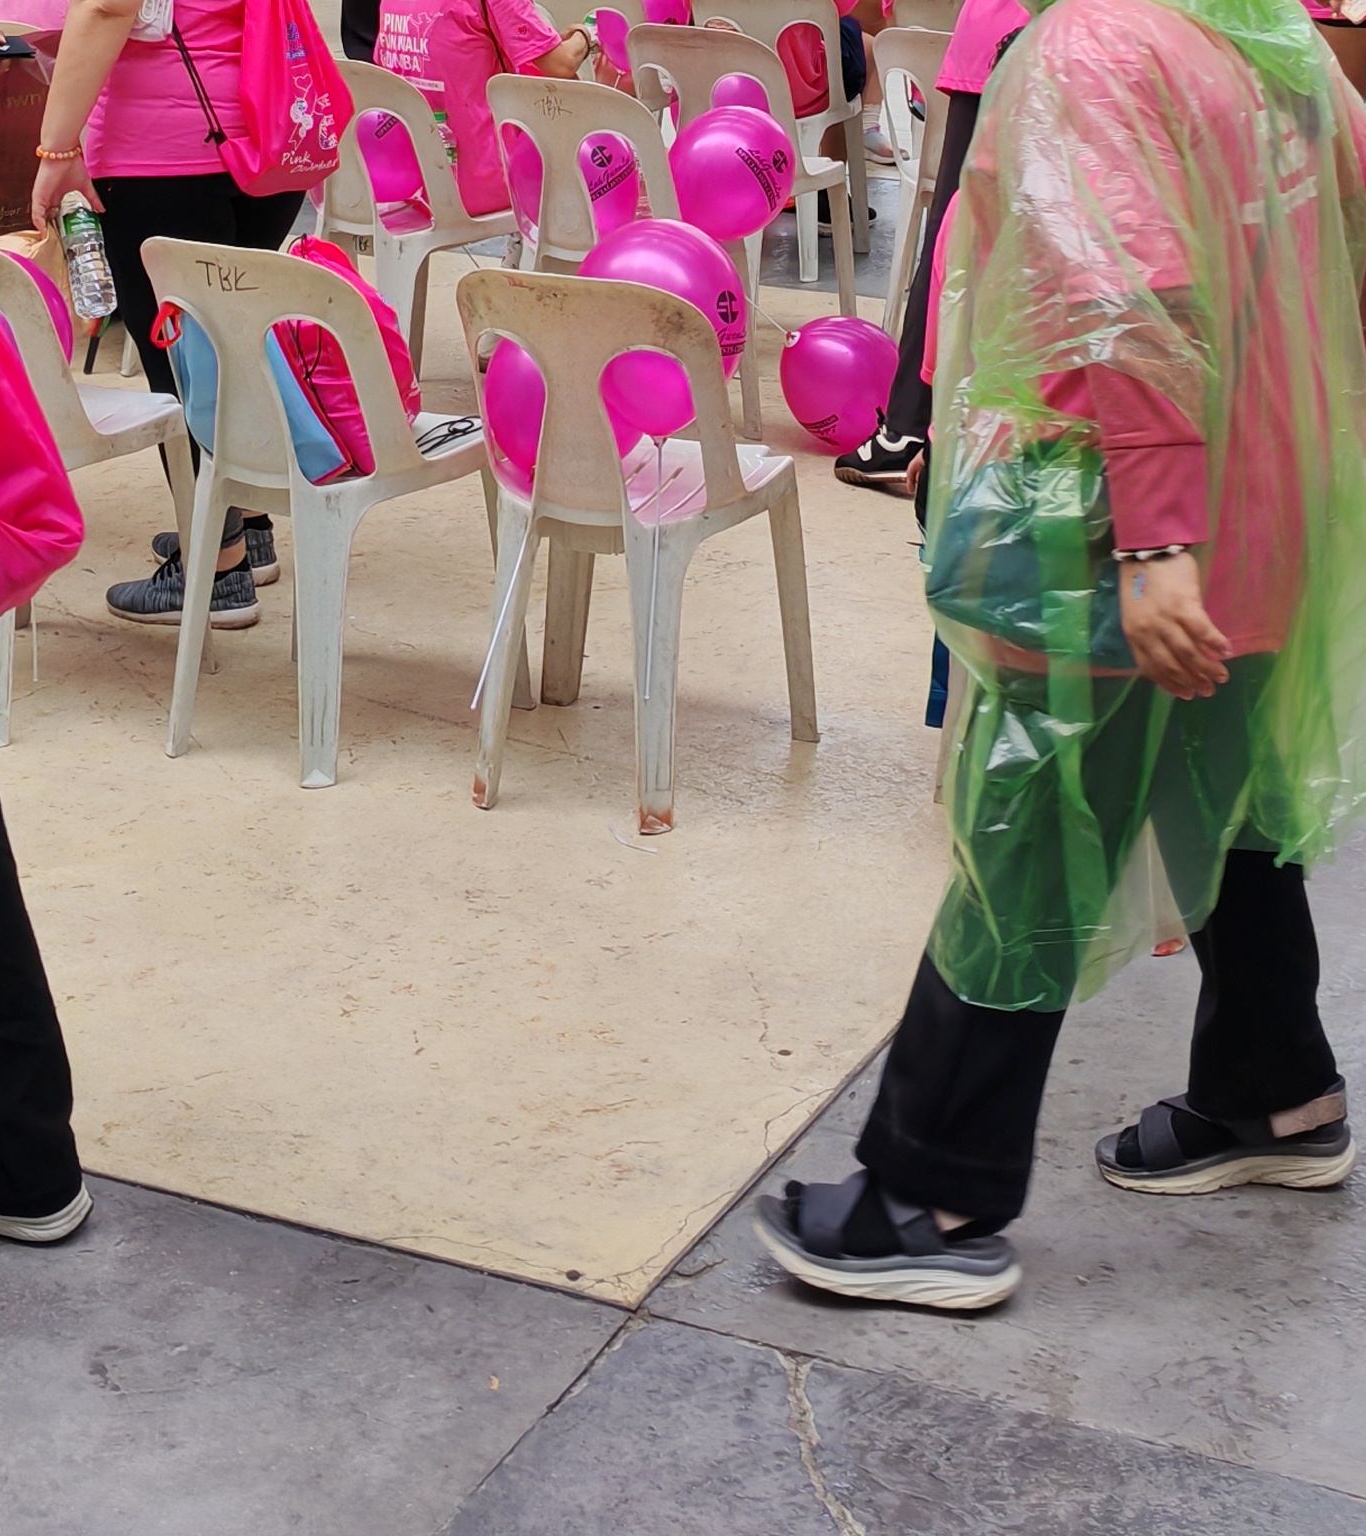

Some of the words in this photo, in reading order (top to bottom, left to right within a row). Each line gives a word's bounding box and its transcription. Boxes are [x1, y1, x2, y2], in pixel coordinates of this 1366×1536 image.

[384, 13, 409, 34] PINK
[398, 36, 428, 55] WALK
[282, 150, 311, 166] Pink
[195, 260, 260, 292] TBK
